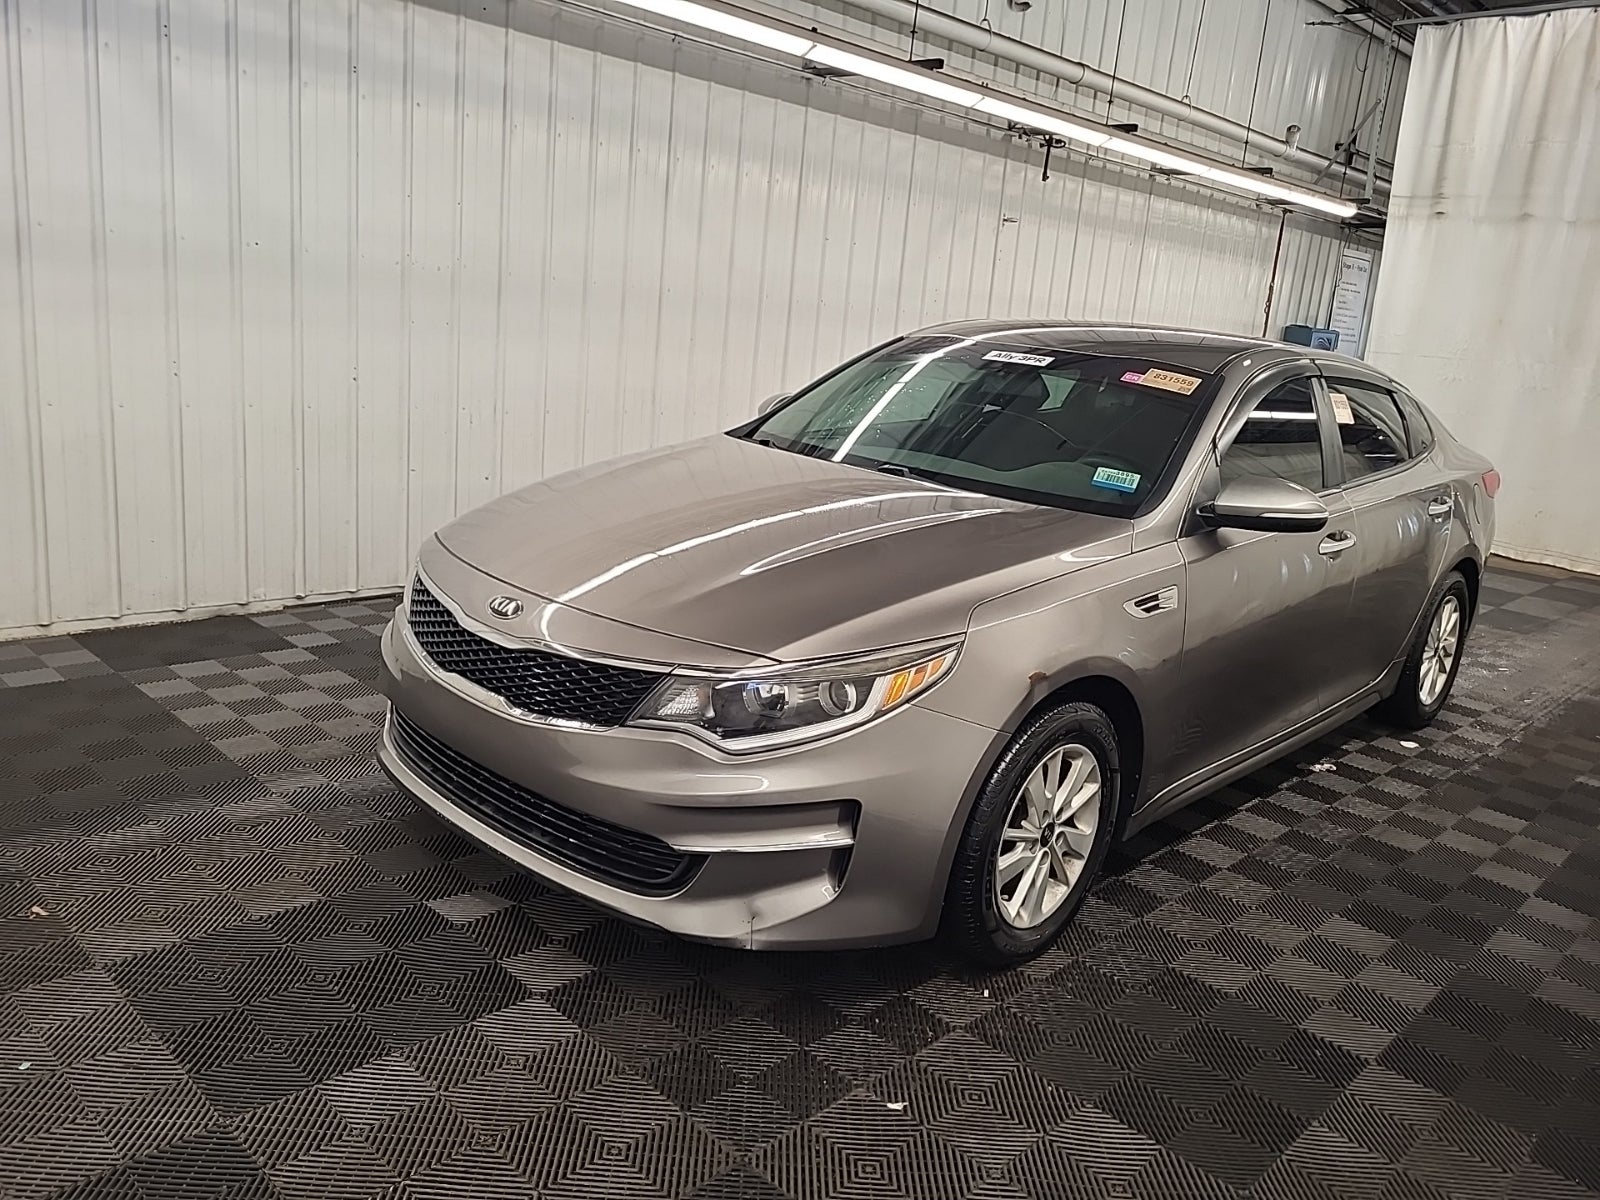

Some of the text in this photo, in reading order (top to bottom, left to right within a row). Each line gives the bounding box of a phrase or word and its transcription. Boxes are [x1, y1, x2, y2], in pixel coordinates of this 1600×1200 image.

[991, 352, 1047, 363] Ally 3PR
[1153, 373, 1194, 387] 831559
[490, 597, 518, 615] KIA
